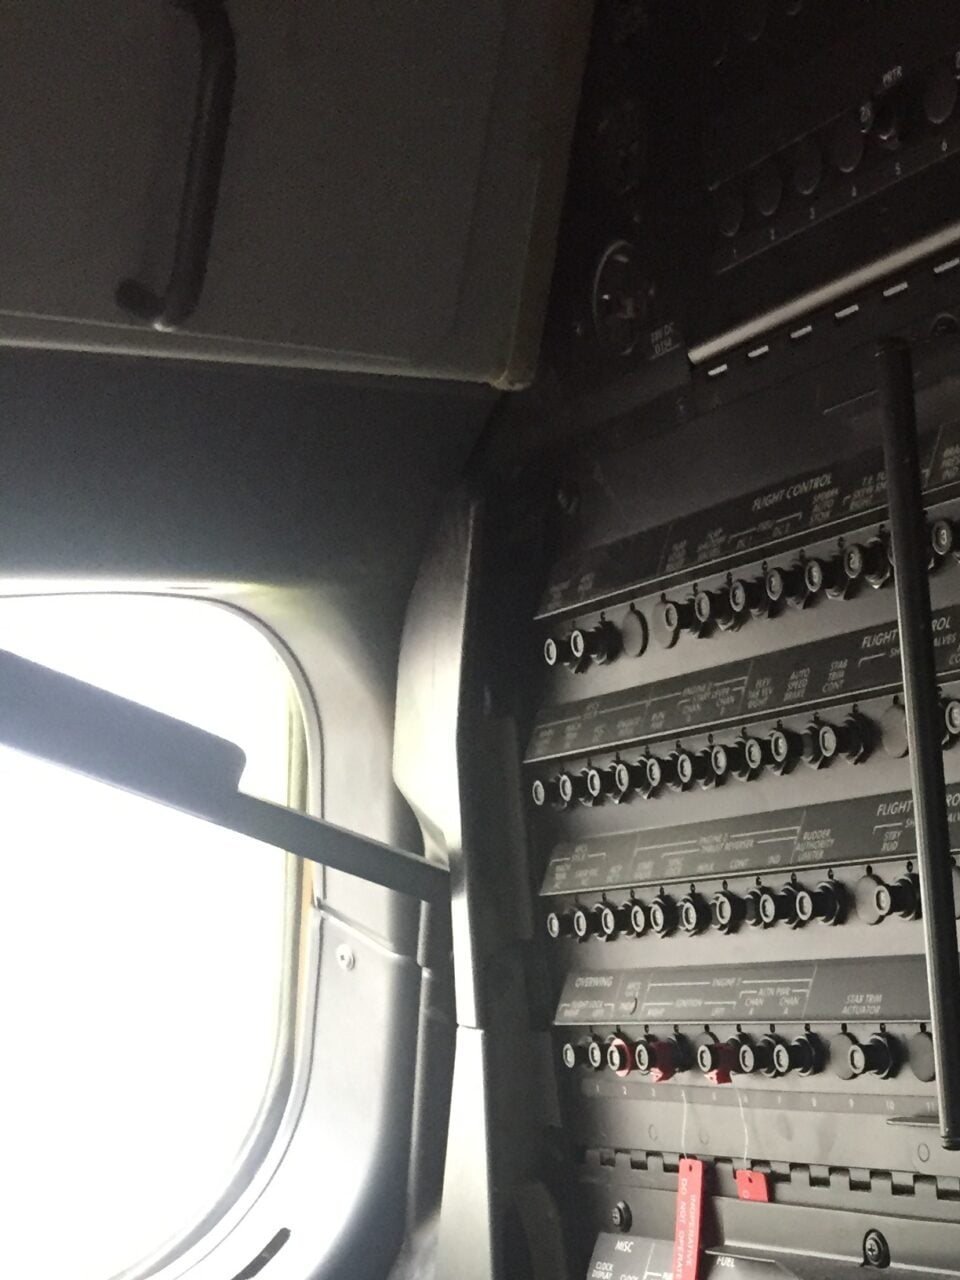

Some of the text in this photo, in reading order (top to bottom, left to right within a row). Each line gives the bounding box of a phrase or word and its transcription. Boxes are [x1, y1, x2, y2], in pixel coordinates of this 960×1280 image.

[786, 473, 833, 501] CONTROL
[876, 800, 912, 817] FLIGHT
[614, 1240, 634, 1253] MISC
[717, 1256, 736, 1268] FUEL
